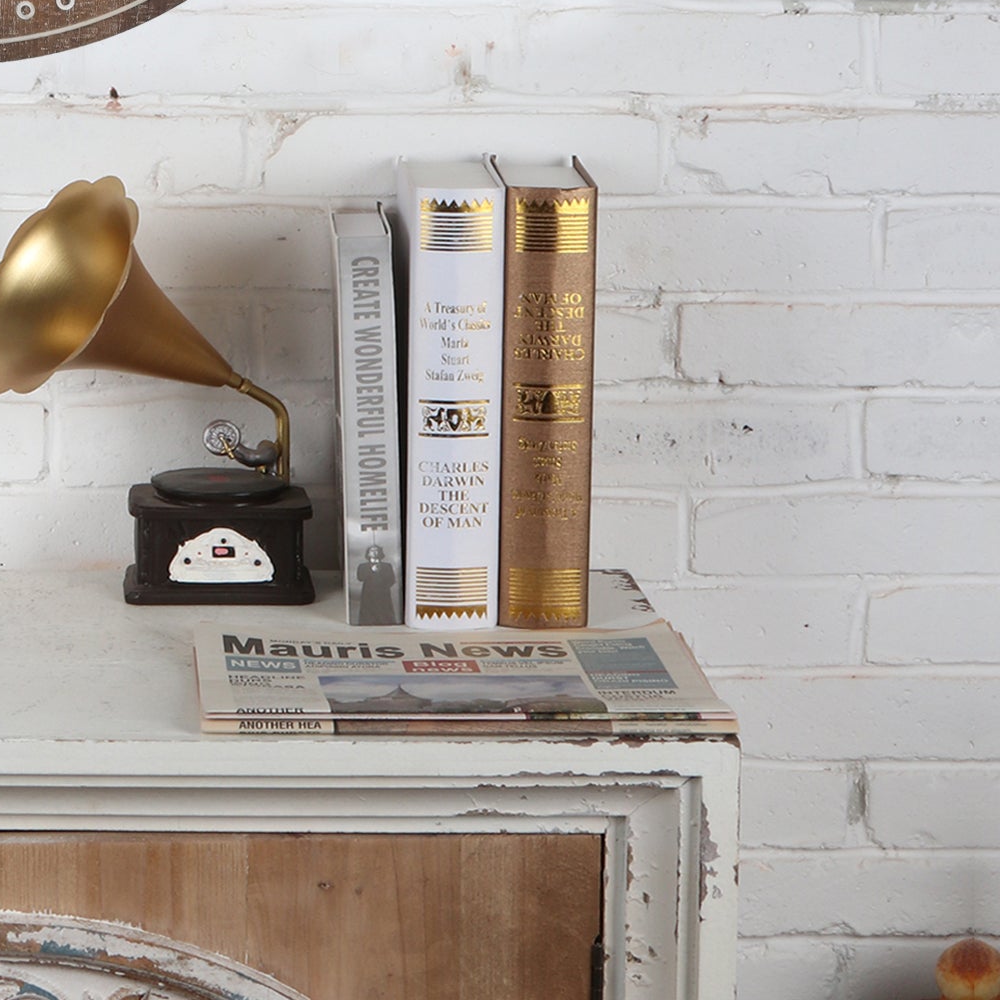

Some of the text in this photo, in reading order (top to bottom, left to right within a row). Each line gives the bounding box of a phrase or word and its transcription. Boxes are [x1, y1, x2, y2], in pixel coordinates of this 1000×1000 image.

[561, 292, 583, 305] OF
[425, 301, 488, 315] A Treasury of
[513, 306, 585, 319] DESCENT
[457, 319, 491, 331] Classics
[534, 319, 567, 333] THE
[519, 333, 583, 347] DARWIN
[440, 353, 470, 366] Stuart
[513, 347, 586, 361] CHARLES
[350, 255, 389, 532] CREATE WONDERFUL HOMELIFE
[418, 461, 489, 473] CHARLES
[422, 475, 485, 488] DARWIN
[438, 490, 470, 501] THE
[419, 503, 488, 514] DESCENT
[422, 517, 482, 529] OF MAN
[222, 634, 405, 659] Mauris
[419, 642, 568, 659] News
[231, 659, 297, 670] NEWS
[412, 660, 469, 668] Blog
[239, 720, 322, 730] ANOTHER HEA
